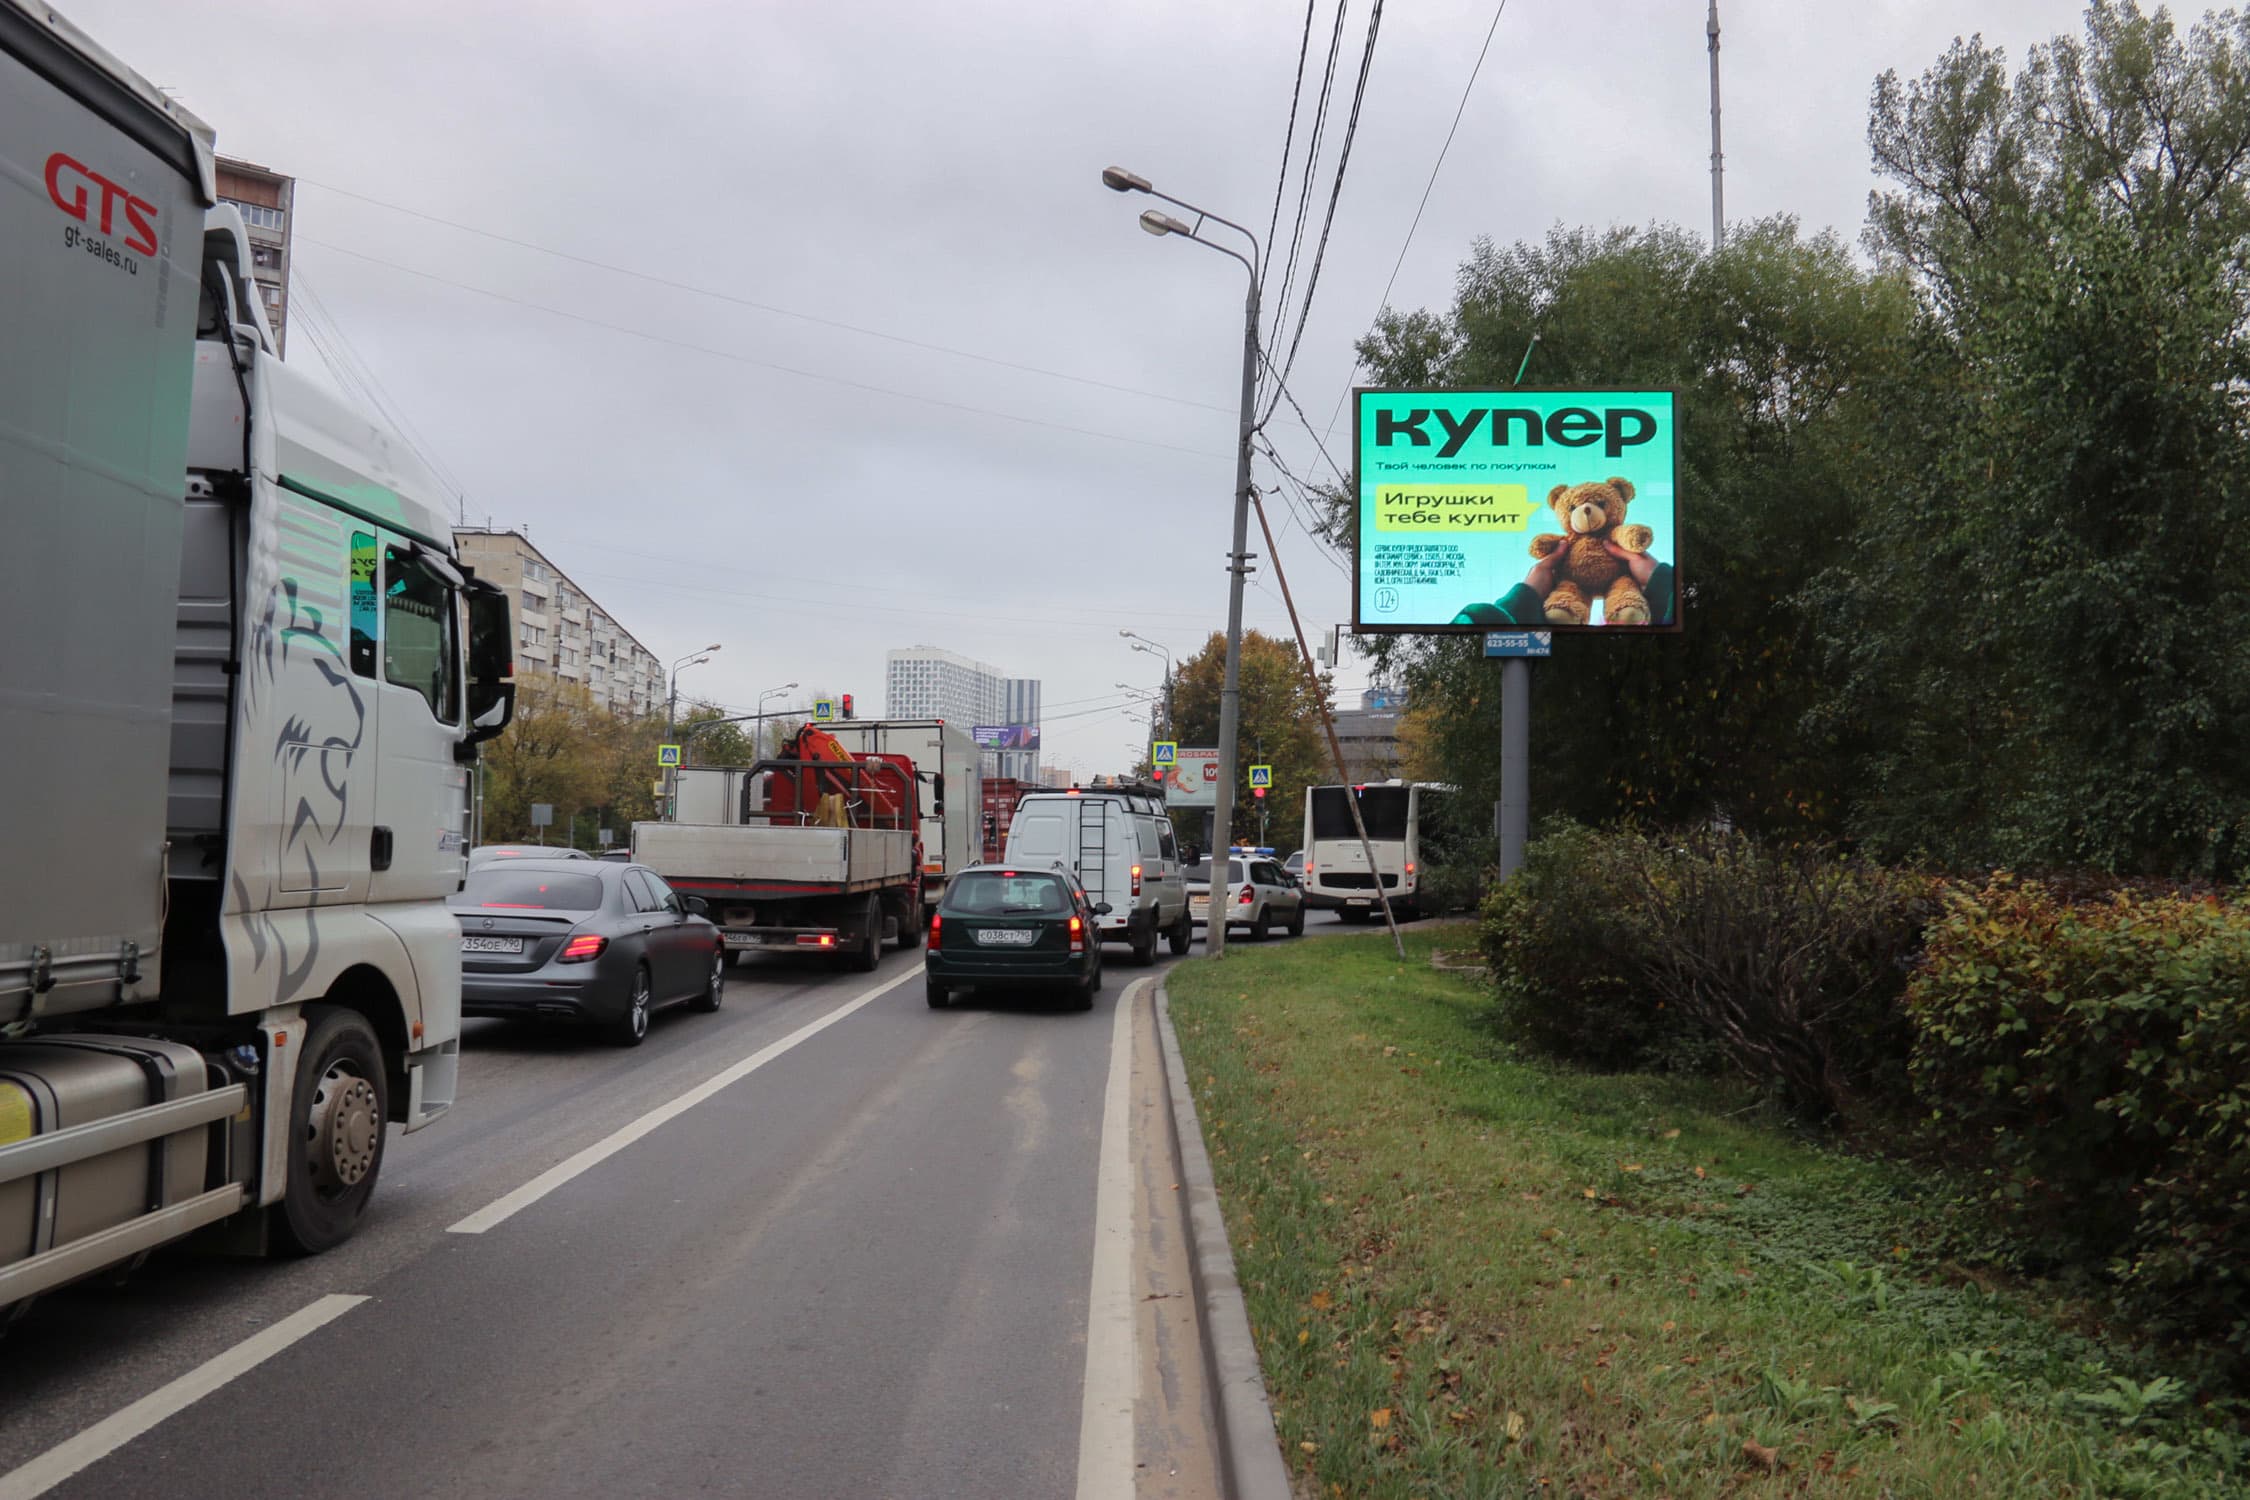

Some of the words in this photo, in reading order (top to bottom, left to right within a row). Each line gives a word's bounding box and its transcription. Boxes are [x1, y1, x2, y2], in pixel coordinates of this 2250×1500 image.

[45, 152, 158, 257] GTS
[64, 226, 138, 276] gt-sales.ru
[1376, 462, 1409, 471] Твой
[1412, 463, 1466, 471] человек
[1470, 463, 1488, 471] по
[1490, 463, 1557, 472] покупкам
[1384, 492, 1495, 508] Игрушки
[1384, 510, 1441, 524] тебе
[1448, 513, 1521, 526] купит
[1379, 591, 1396, 608] 12+
